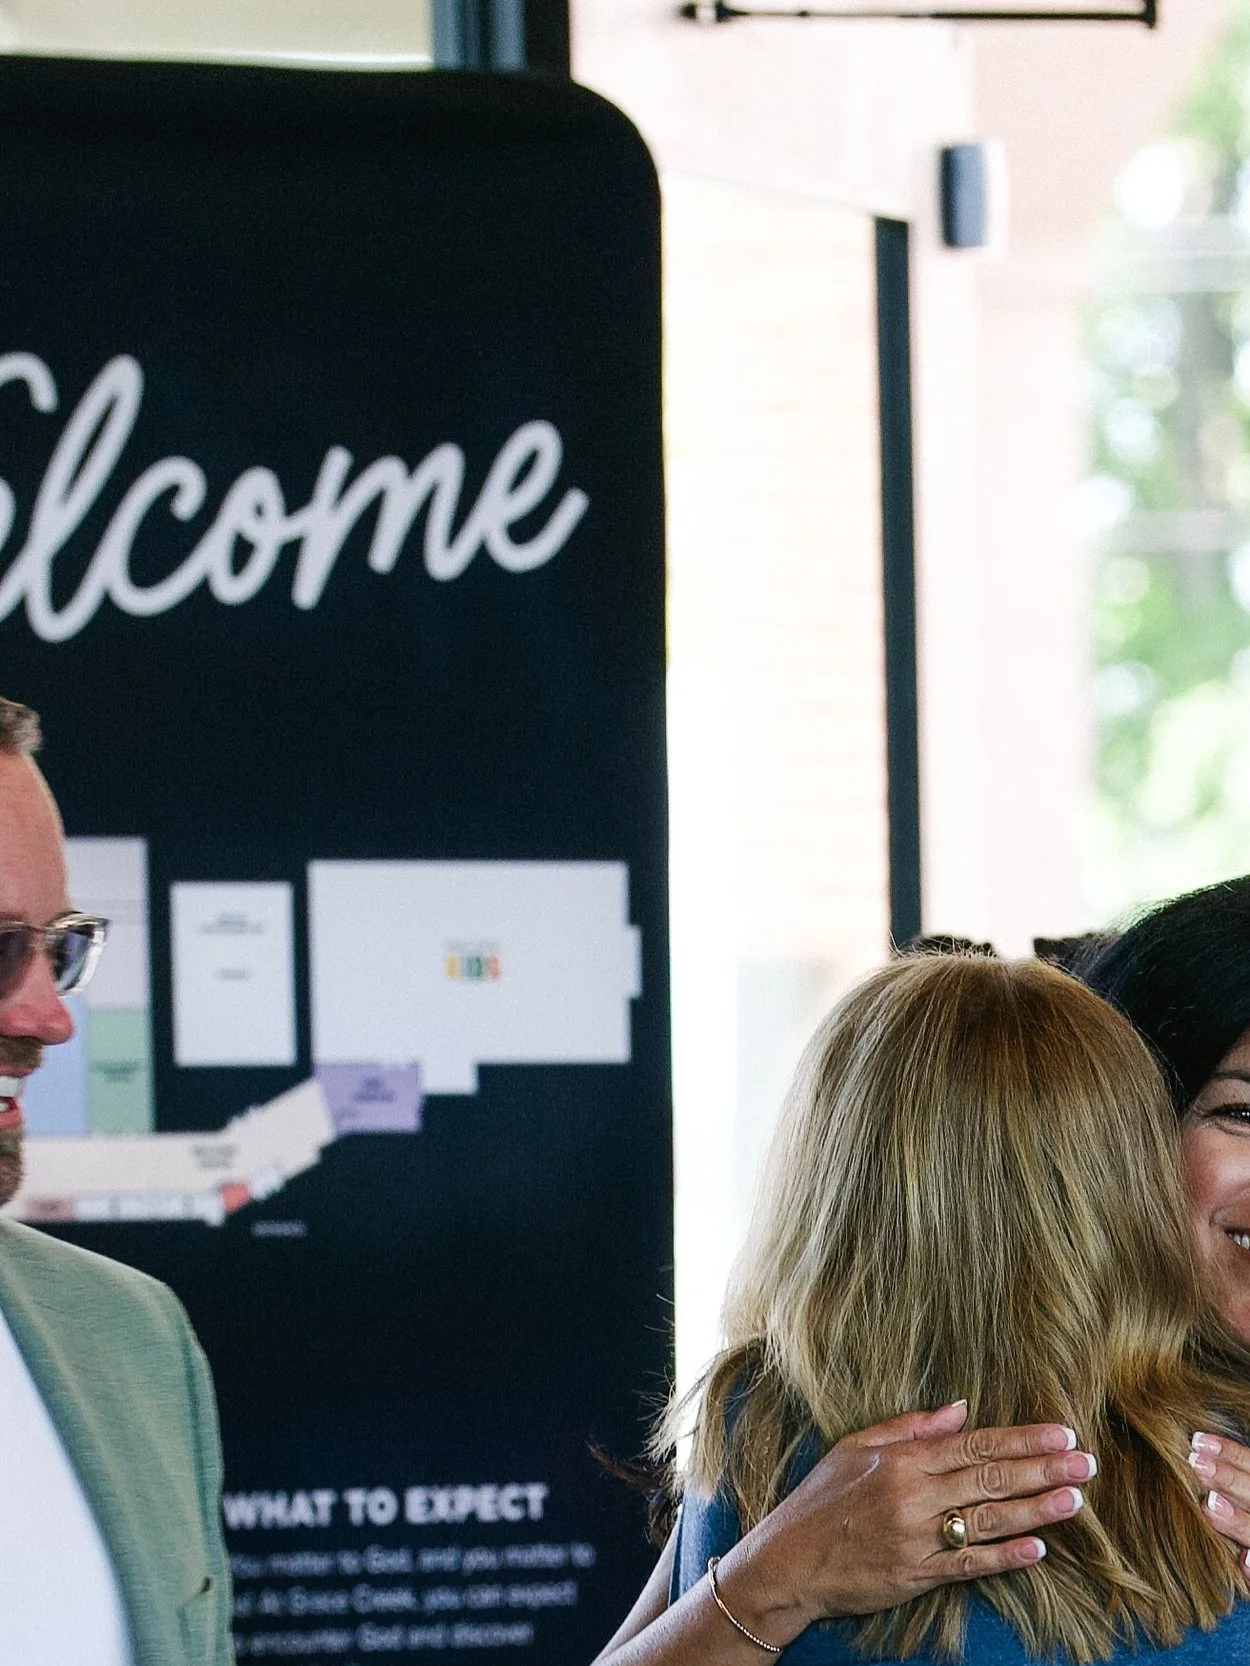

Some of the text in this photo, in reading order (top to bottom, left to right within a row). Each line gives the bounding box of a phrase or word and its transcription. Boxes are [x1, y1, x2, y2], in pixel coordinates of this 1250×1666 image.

[0, 352, 589, 642] lcome
[224, 1482, 549, 1529] WHAT TO EXPECT
